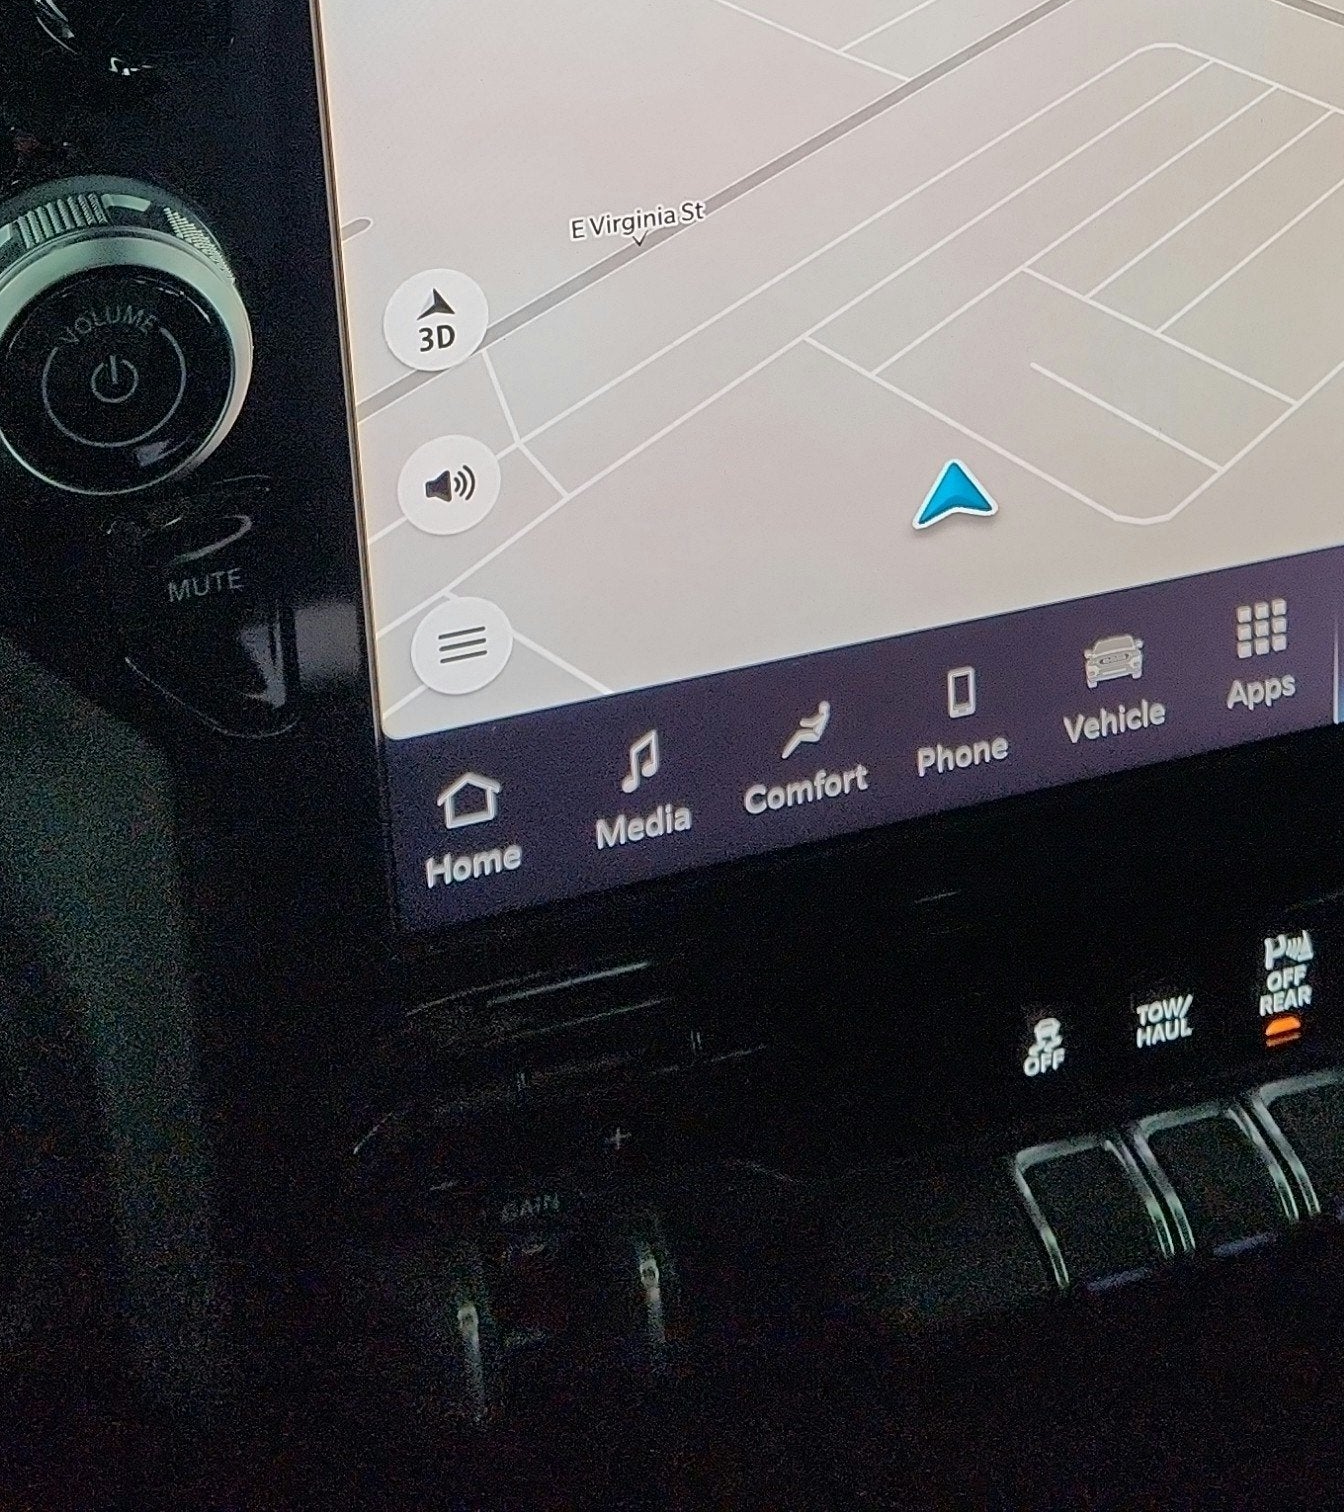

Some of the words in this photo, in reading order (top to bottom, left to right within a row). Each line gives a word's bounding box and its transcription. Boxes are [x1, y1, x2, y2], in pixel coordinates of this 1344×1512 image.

[572, 220, 584, 239] E
[590, 206, 675, 235] Virginia
[681, 202, 704, 222] St
[57, 305, 158, 345] VOLUME
[419, 325, 455, 352] 3D
[168, 567, 242, 602] MUTE
[1227, 674, 1295, 711] Apps
[1063, 699, 1165, 744] Vehicle
[917, 736, 1009, 777] Phone
[744, 764, 868, 815] Comfort
[596, 803, 692, 850] Media
[425, 845, 522, 888] Home
[1266, 964, 1307, 992] OFF
[1259, 986, 1311, 1016] REAR
[1136, 1018, 1192, 1048] HAUL
[1023, 1048, 1065, 1077] OFF
[502, 1194, 559, 1221] GAIN
